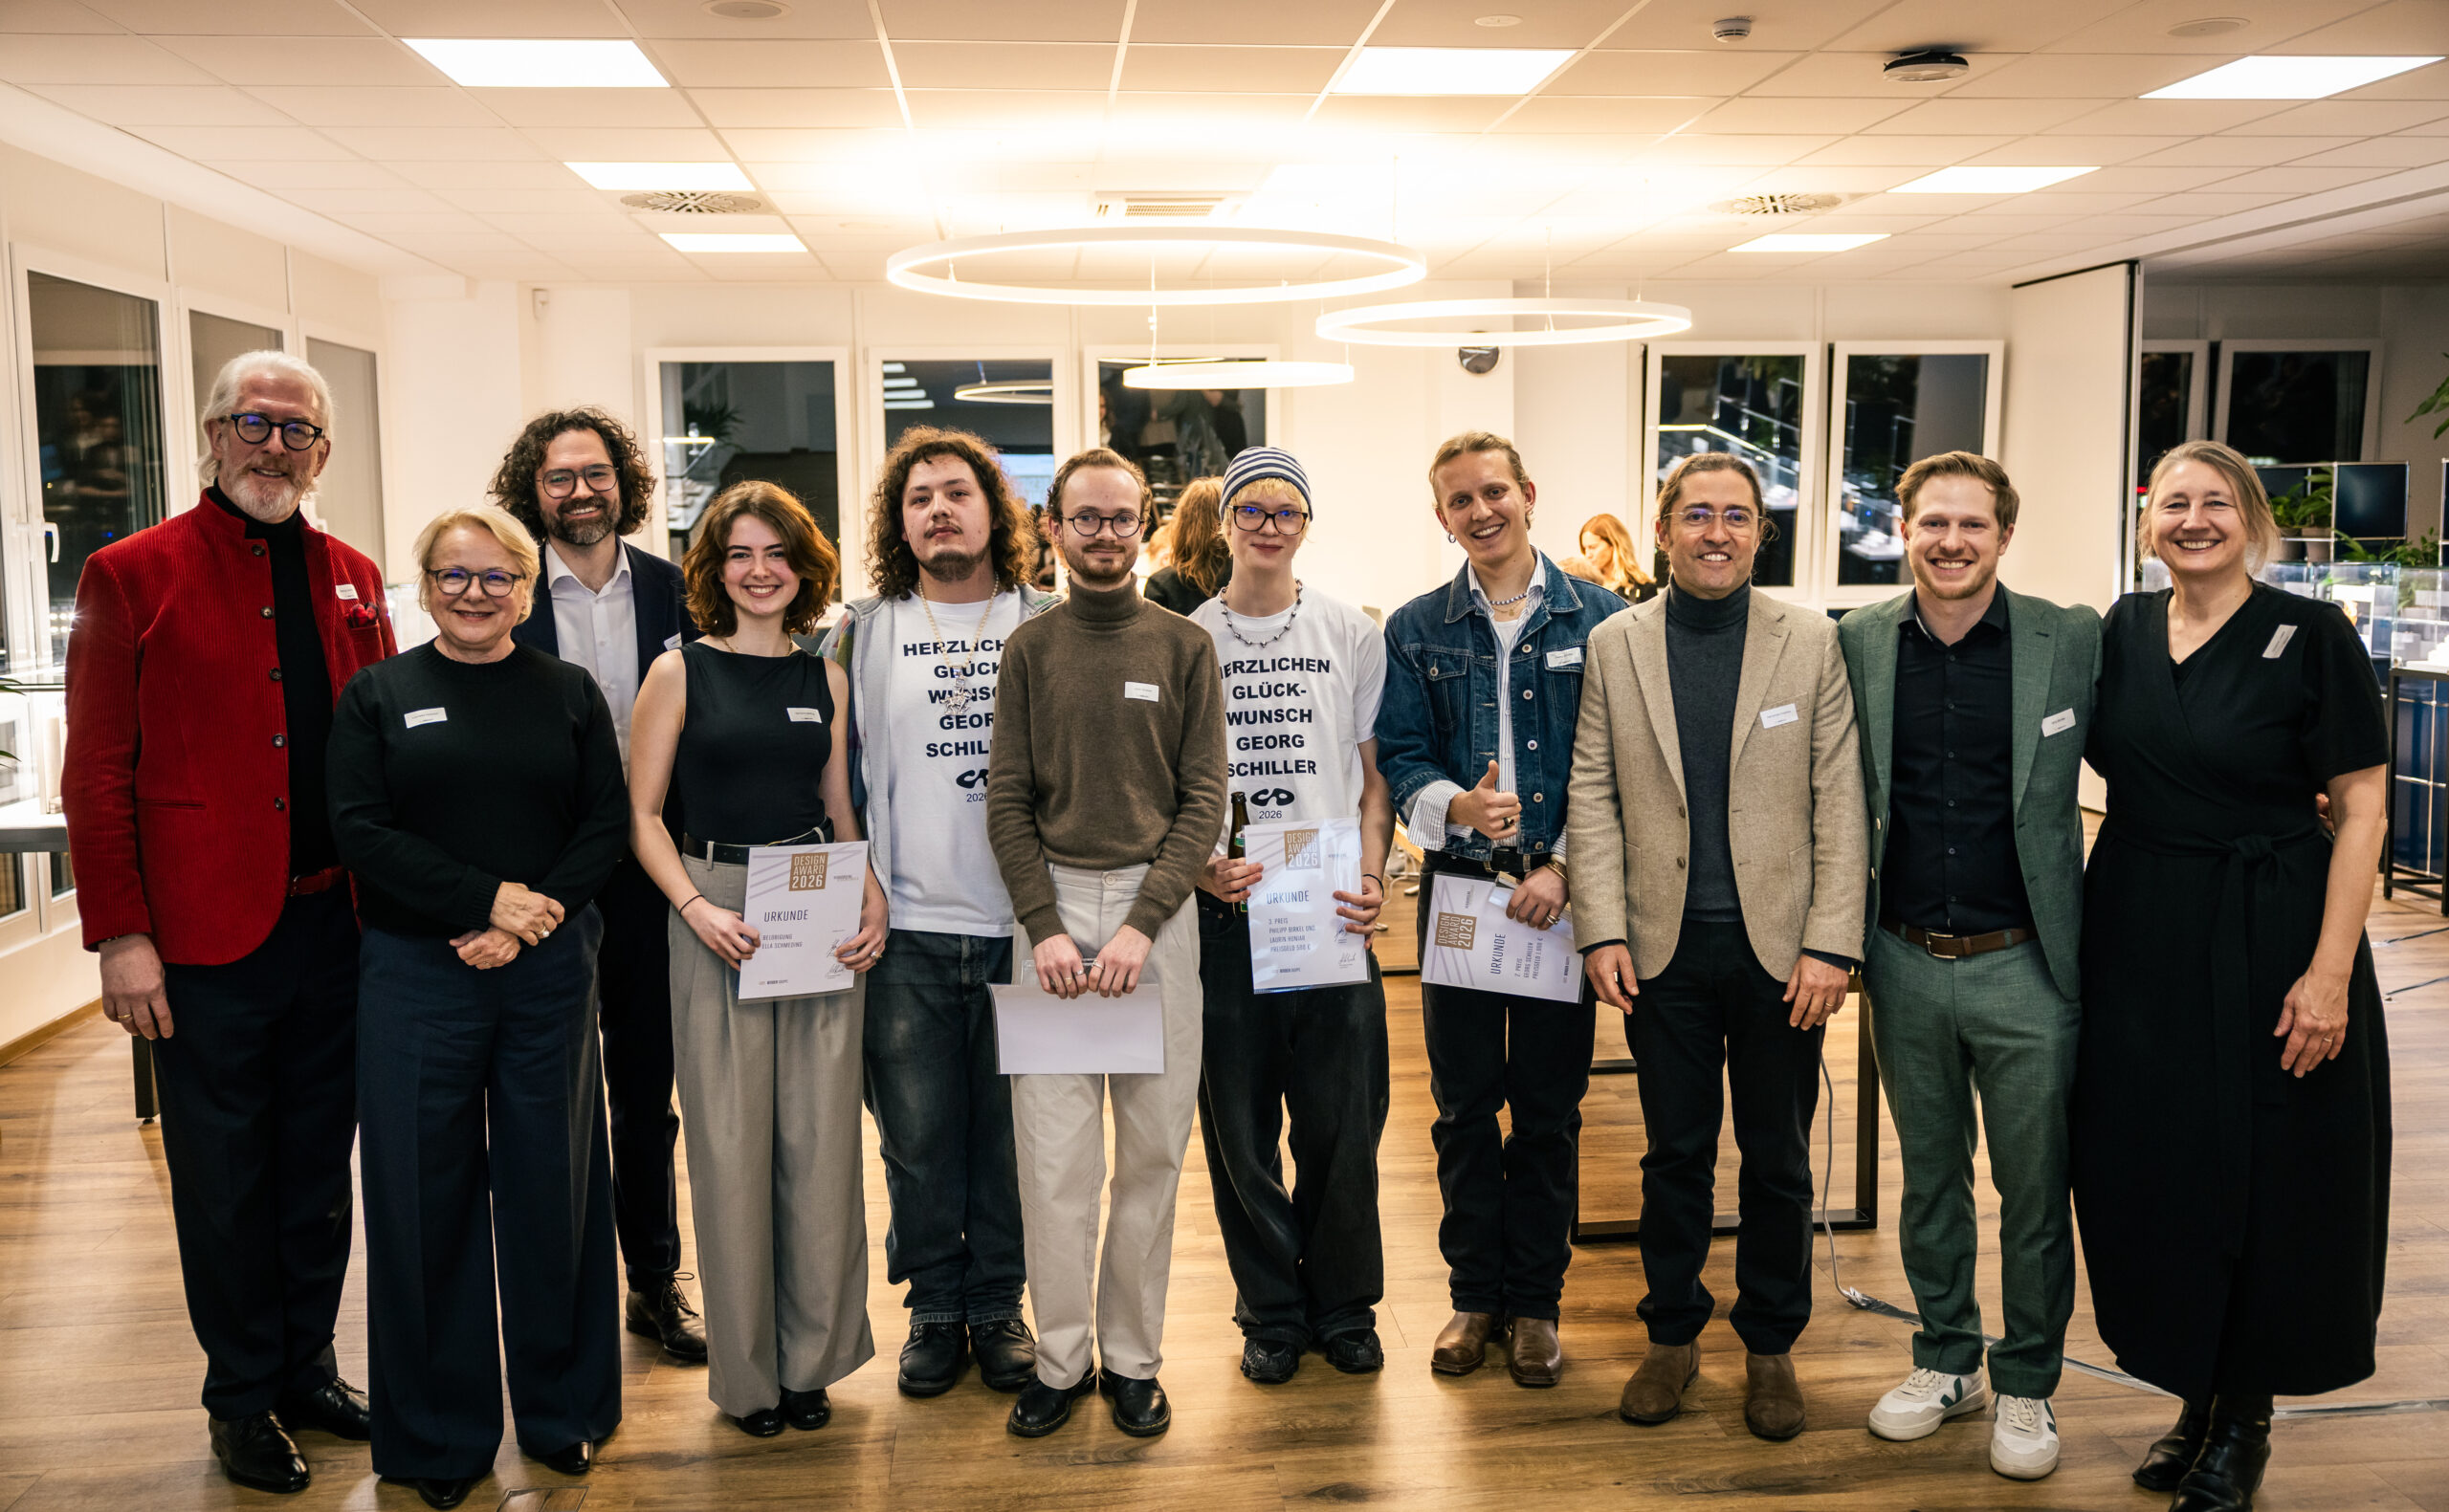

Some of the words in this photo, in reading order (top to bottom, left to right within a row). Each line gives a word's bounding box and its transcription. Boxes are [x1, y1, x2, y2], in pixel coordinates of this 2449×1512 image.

[1232, 681, 1307, 700] GLÜCK-
[1226, 708, 1313, 726] WUNSCH
[1236, 734, 1305, 751] GEORG
[1228, 759, 1316, 778] SCHILLER
[1258, 810, 1283, 820] 2026
[1287, 832, 1317, 843] DESIGN
[1288, 842, 1317, 853] AWARD
[794, 855, 826, 866] DESIGN
[1288, 852, 1318, 866] 2026
[793, 865, 825, 876] AWARD
[792, 875, 823, 888] 2026
[1267, 890, 1310, 904] URKUNDE
[763, 909, 809, 922] URKUNDE
[1437, 914, 1451, 944] DESIGN
[1448, 916, 1461, 946] AWARD
[1458, 918, 1474, 948] 2026
[1489, 932, 1507, 975] URKUNDE
